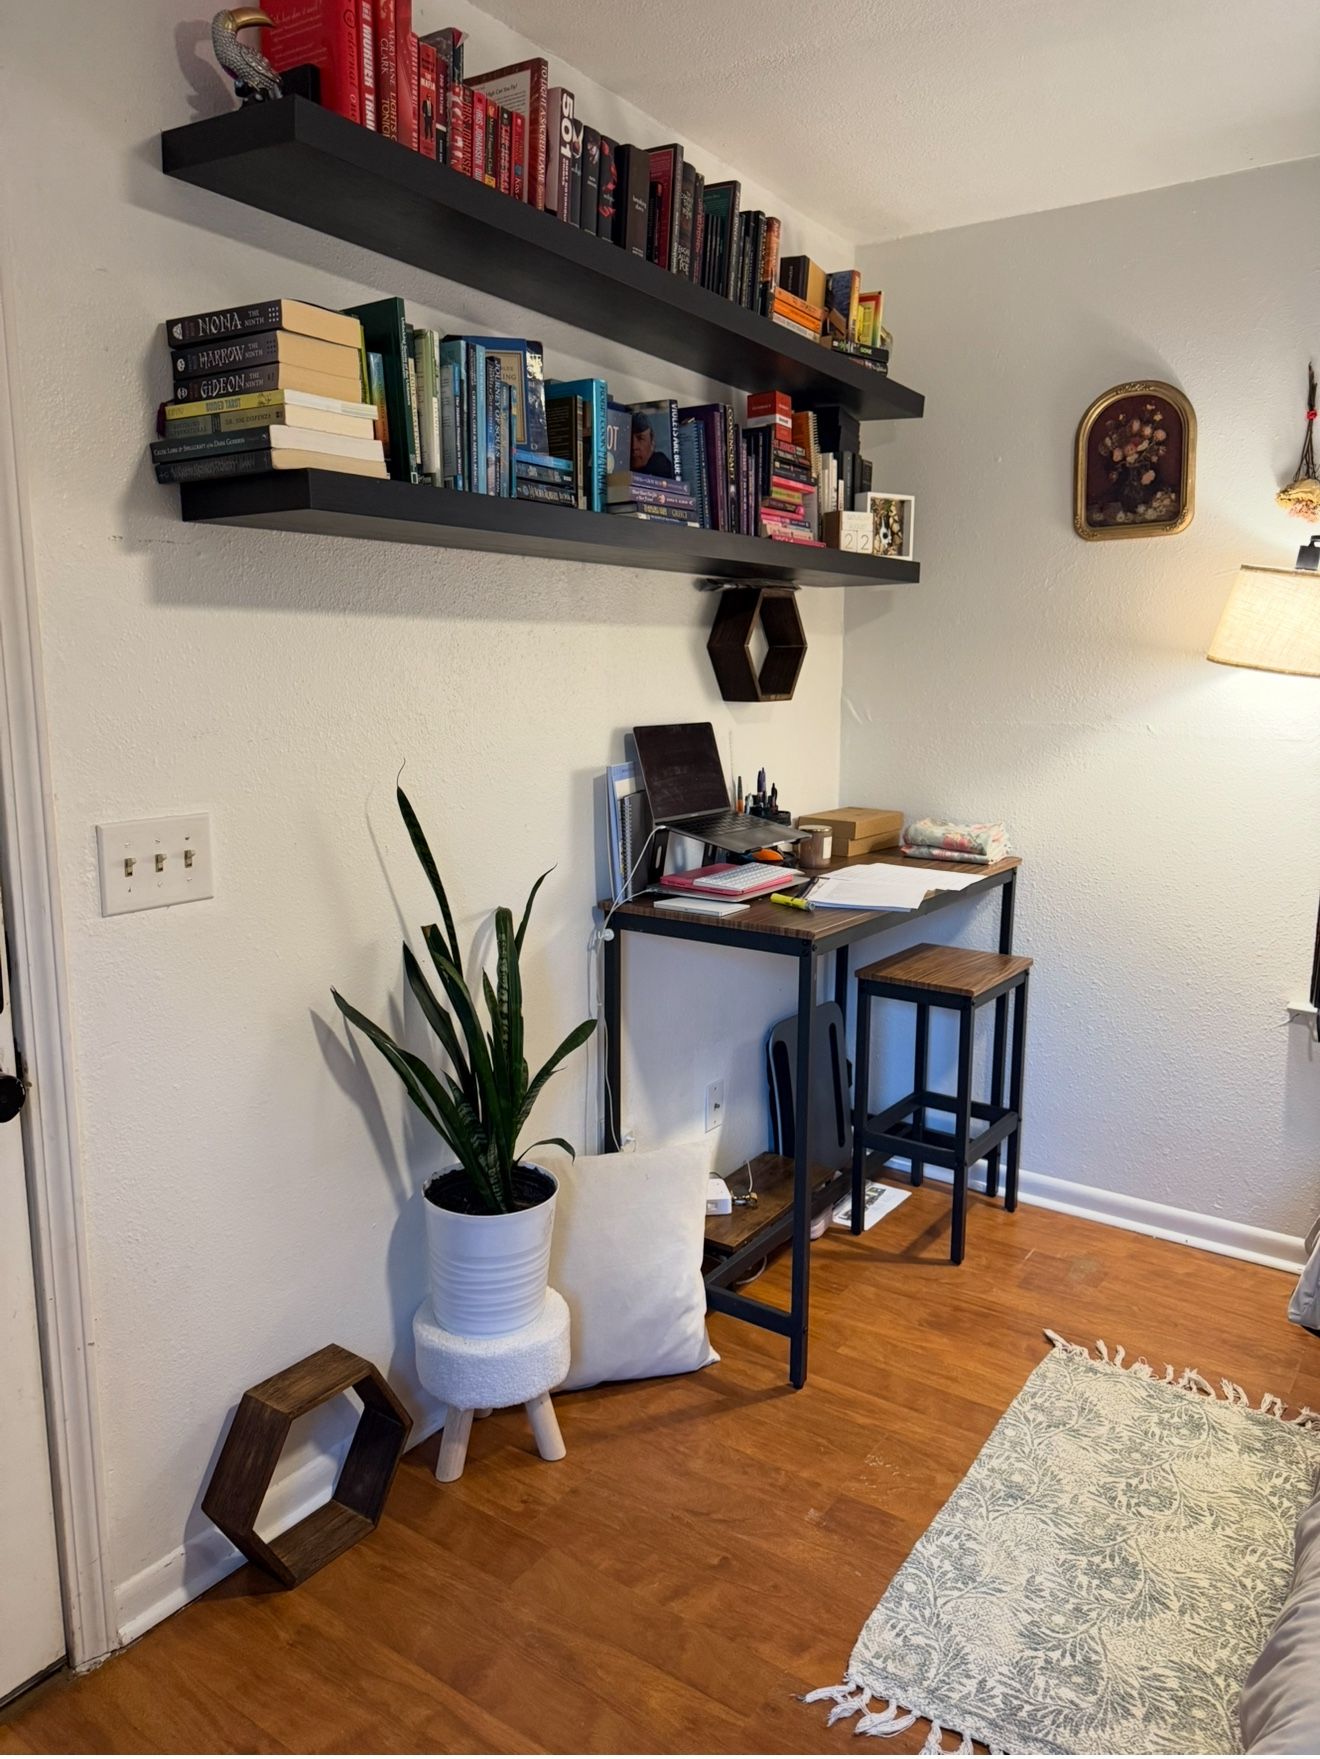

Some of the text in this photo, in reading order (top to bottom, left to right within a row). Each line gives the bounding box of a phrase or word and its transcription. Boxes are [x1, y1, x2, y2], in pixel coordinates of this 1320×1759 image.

[362, 24, 375, 88] MURDER
[380, 38, 389, 74] CLARK
[388, 27, 397, 86] MARY JANE
[390, 92, 398, 132] LIGHTS
[463, 102, 472, 123] IRIS
[475, 110, 483, 124] IRIS
[560, 93, 574, 159] 501
[474, 126, 483, 164] JOHANSEN
[198, 309, 260, 336] NONA THE
[244, 316, 264, 327] NINTH
[198, 342, 259, 369] HARROW THE
[244, 349, 264, 359] NINTH
[245, 379, 264, 388] NINTH
[248, 371, 260, 380] THE
[205, 397, 241, 412] GUIDED TAROT
[494, 410, 501, 423] OF
[599, 420, 607, 448] COOK
[671, 403, 682, 474] VIOLETS ARE BLUE
[727, 408, 735, 480] COVENCRAFT
[597, 450, 607, 496] MARKER
